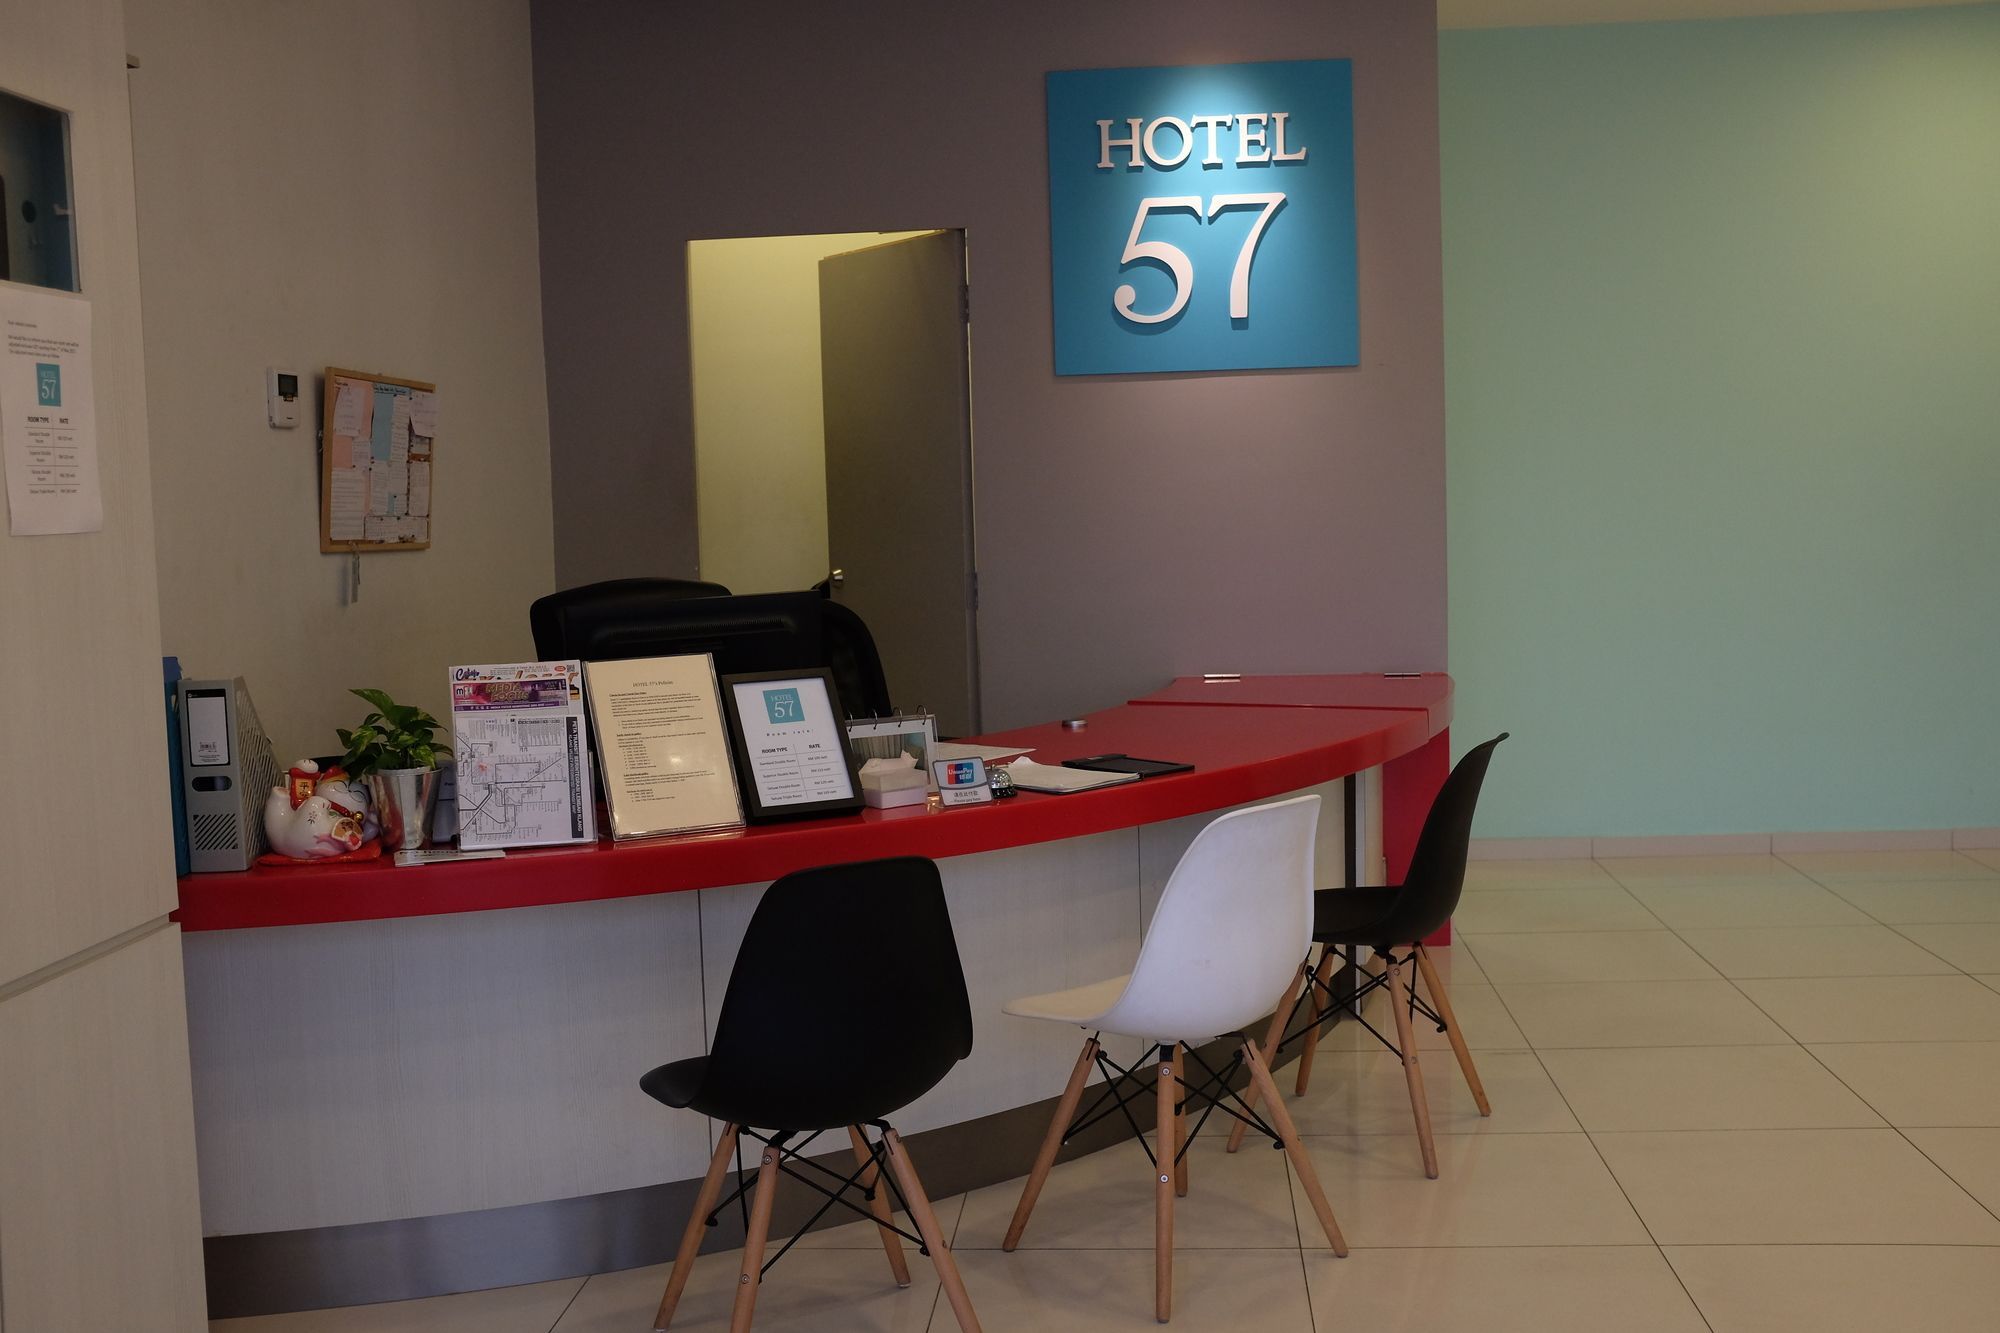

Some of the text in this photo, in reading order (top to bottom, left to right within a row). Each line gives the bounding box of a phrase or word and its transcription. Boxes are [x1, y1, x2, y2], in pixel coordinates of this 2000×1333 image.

[1096, 112, 1306, 169] HOTEL
[1113, 192, 1287, 324] 57
[42, 379, 56, 400] 57
[485, 682, 522, 693] MEDIA
[490, 692, 530, 702] FOCUS
[770, 694, 792, 702] HOTEL
[774, 700, 794, 718] 57
